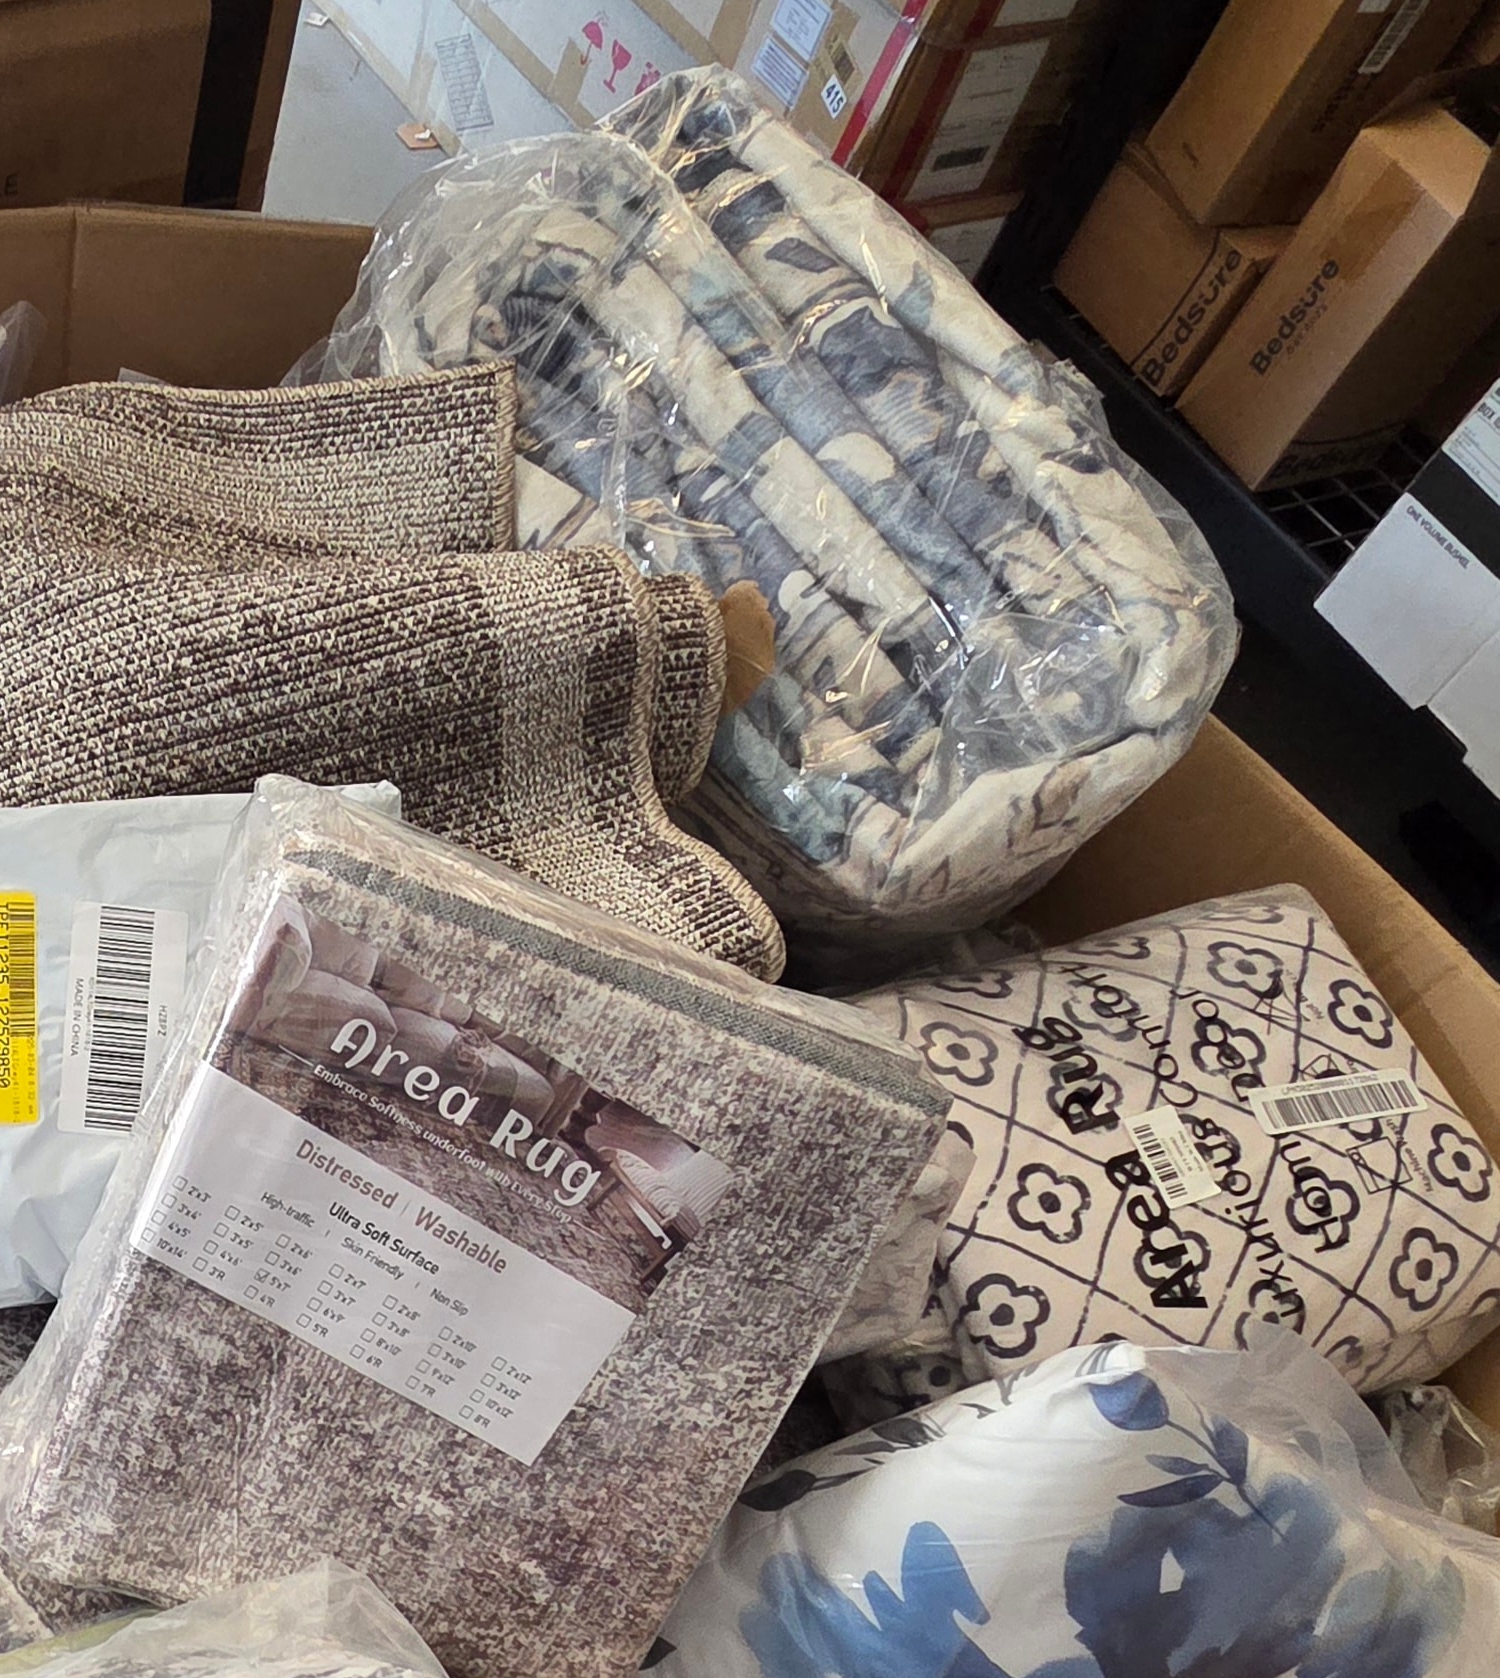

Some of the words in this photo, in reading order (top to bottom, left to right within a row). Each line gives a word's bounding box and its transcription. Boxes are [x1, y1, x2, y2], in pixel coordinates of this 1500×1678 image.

[826, 83, 845, 114] 415
[1141, 250, 1242, 386] Bedsure
[1250, 259, 1339, 375] Bedsure
[69, 1023, 80, 1057] CHINA
[71, 977, 83, 1007] MADE
[72, 1009, 81, 1021] IN
[329, 1015, 481, 1128] Area
[490, 1108, 603, 1212] Rug
[1014, 1015, 1120, 1135] Rug
[295, 1138, 399, 1210] Distressed
[412, 1205, 511, 1275] Washable
[421, 1128, 487, 1173] underfoot
[1278, 1139, 1350, 1254] Hom
[259, 1190, 315, 1230] High-traffic
[340, 1236, 365, 1257] Skin
[363, 1249, 406, 1282] Friendly
[429, 1287, 452, 1307] Non
[448, 1298, 470, 1318] Slip
[327, 1201, 363, 1230] Ultra
[360, 1220, 392, 1247] Soft
[388, 1236, 442, 1276] Surface
[1106, 1152, 1208, 1309] Area
